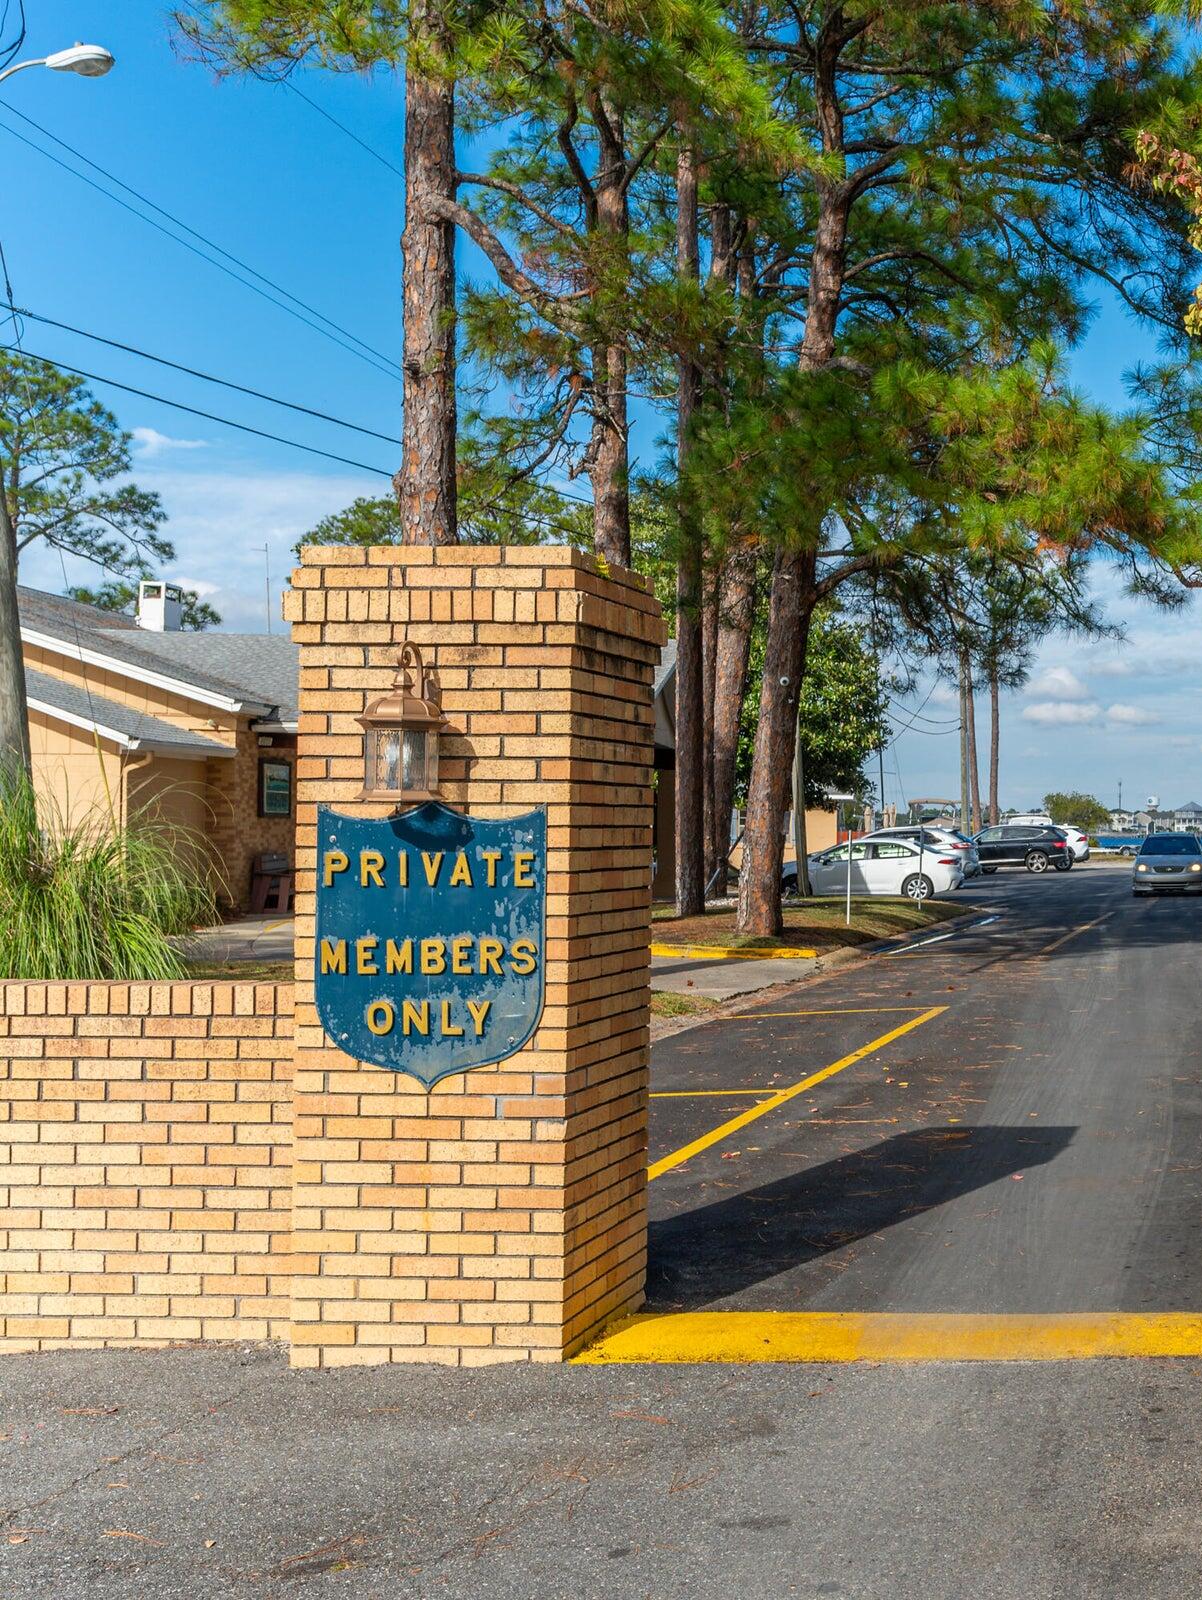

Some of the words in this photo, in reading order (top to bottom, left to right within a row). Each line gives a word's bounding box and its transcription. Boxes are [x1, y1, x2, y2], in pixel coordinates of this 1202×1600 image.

[323, 851, 536, 888] PRIVATE
[320, 938, 538, 975] MEMBERS
[366, 1000, 493, 1036] ONLY
